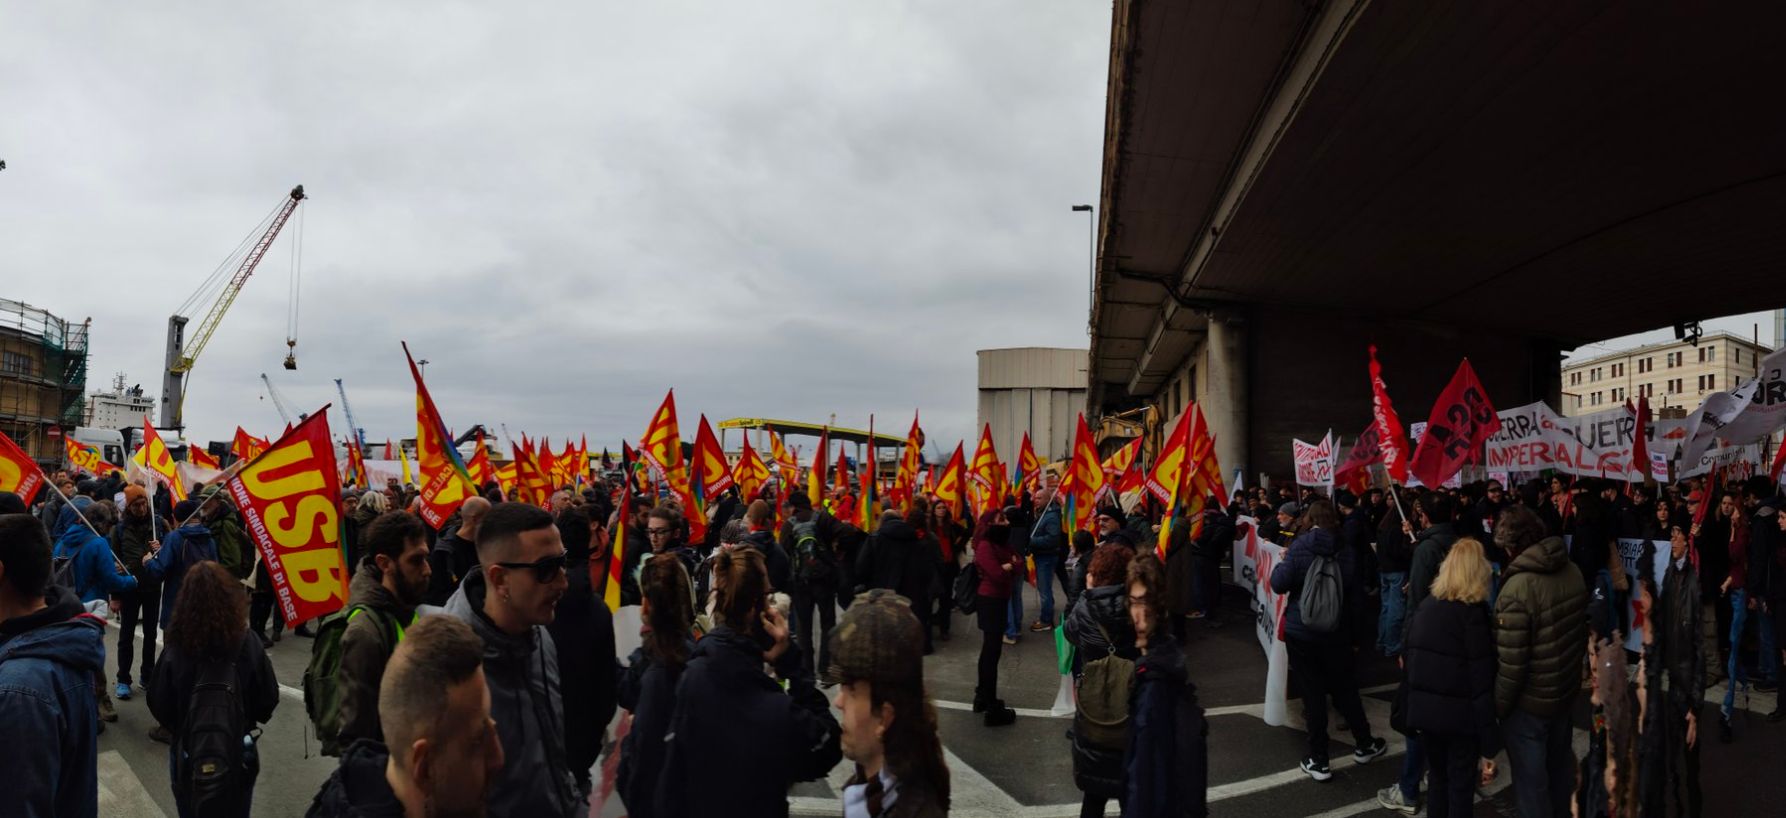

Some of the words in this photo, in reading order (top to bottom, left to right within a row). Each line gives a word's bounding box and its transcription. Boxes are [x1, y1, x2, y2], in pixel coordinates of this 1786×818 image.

[239, 440, 344, 602] USB
[245, 504, 281, 570] SINDACALE
[272, 572, 285, 586] DI
[278, 587, 299, 622] BASE
